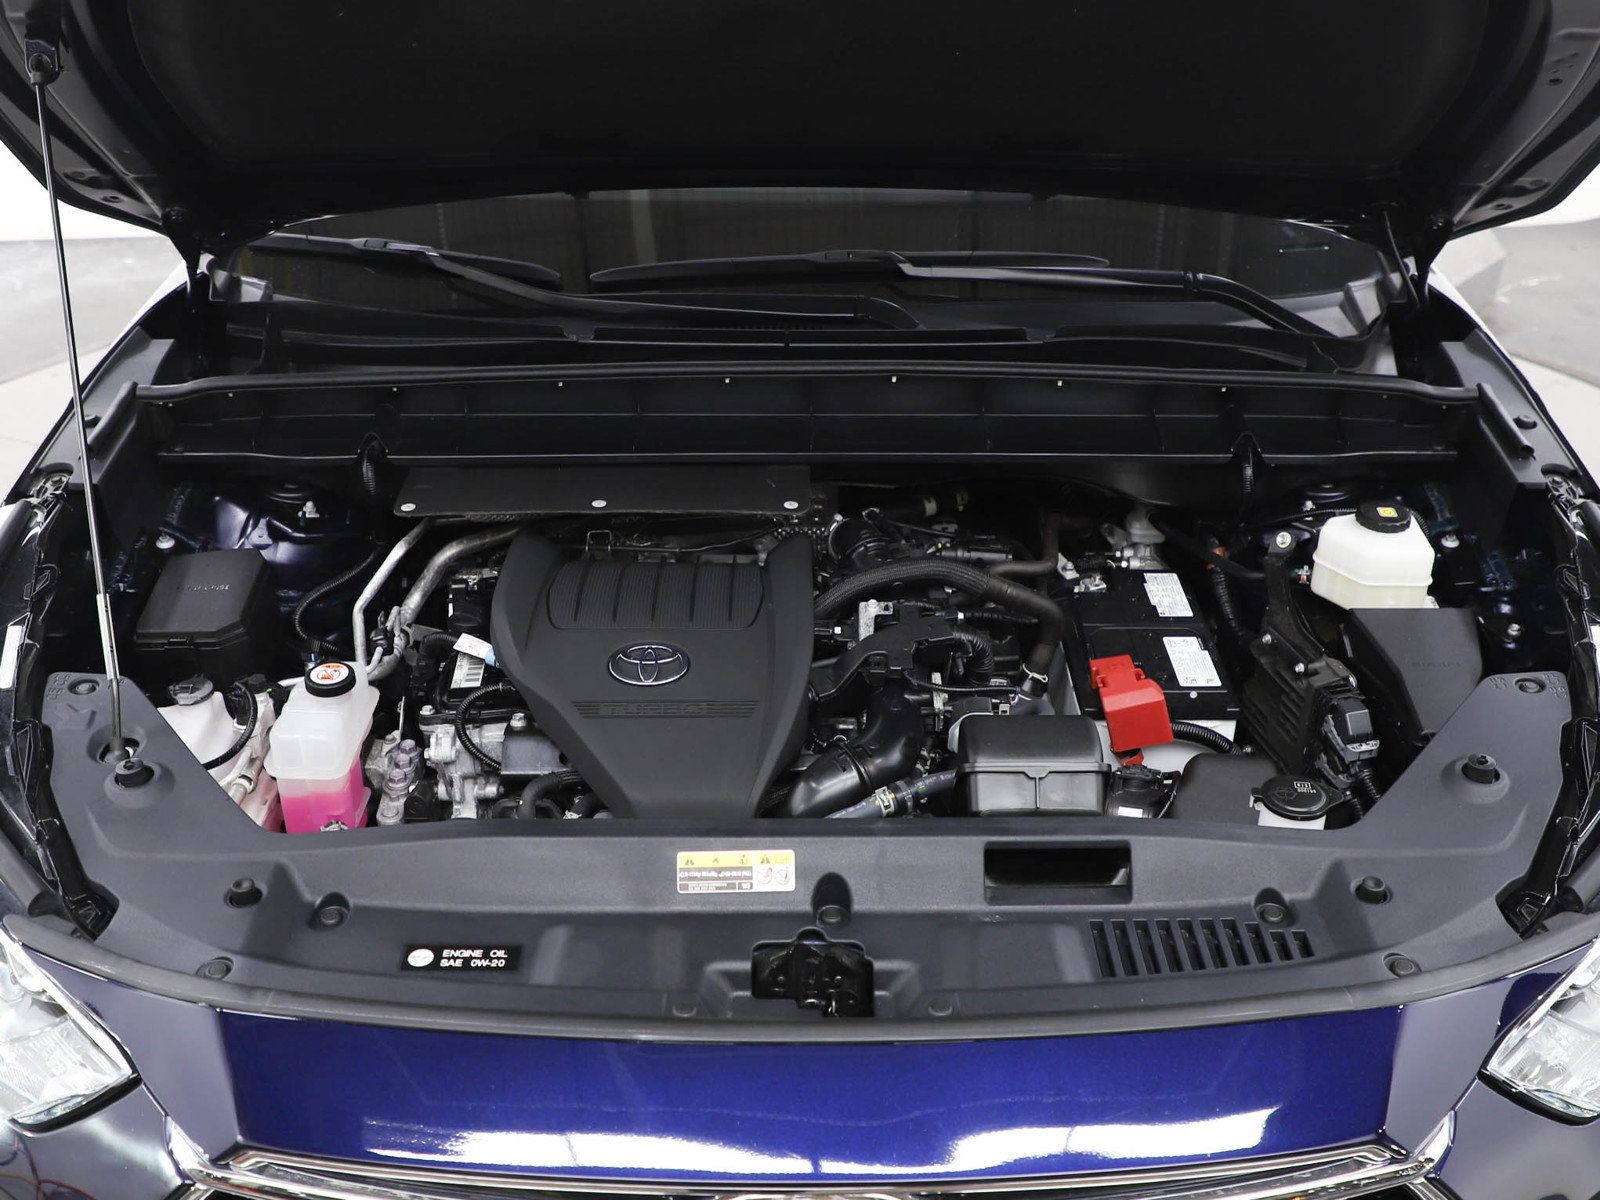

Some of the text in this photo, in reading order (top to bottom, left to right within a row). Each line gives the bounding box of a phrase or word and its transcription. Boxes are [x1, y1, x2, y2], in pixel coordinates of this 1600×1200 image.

[442, 949, 483, 958] ENGINE
[490, 949, 508, 958] OIL
[440, 958, 506, 967] SAE 0W-20
